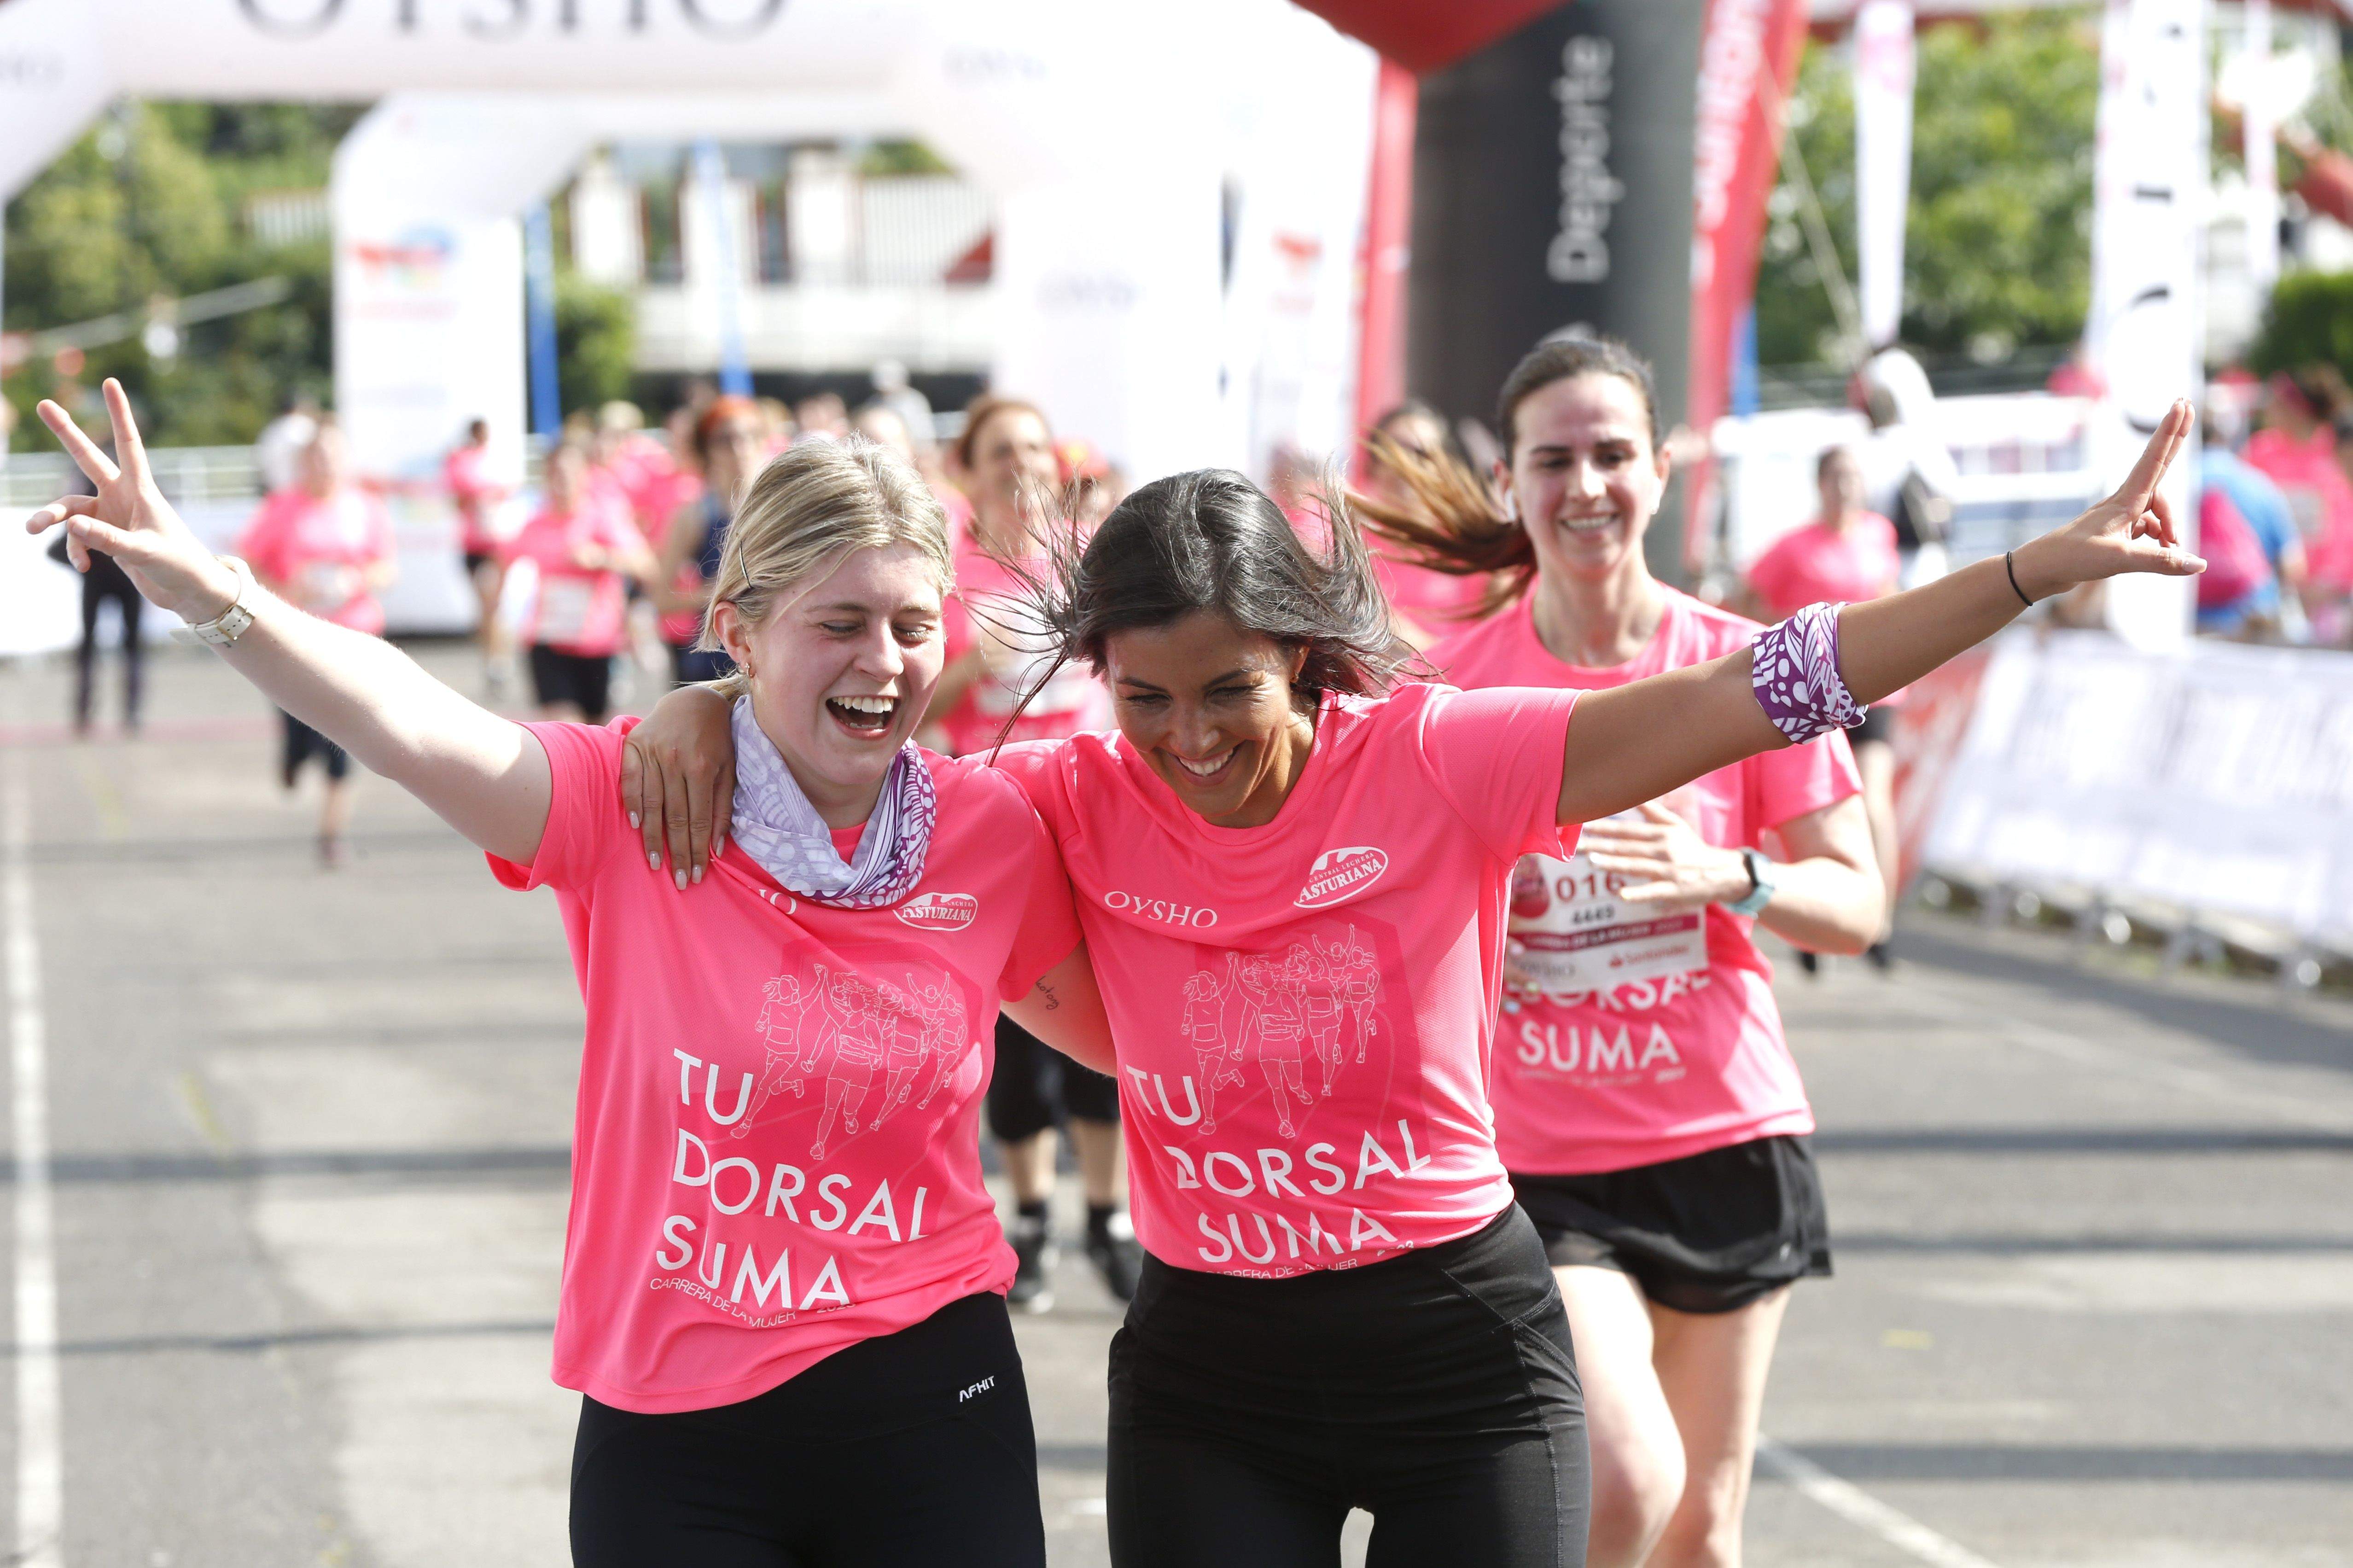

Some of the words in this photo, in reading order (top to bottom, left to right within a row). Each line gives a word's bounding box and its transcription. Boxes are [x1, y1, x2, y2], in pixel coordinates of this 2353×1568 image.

[1547, 35, 1625, 283] Deporte
[1299, 859, 1383, 903] ASTURIANA
[1309, 867, 1340, 883] CENTRAL
[1342, 852, 1374, 870] LECHERA
[902, 907, 971, 921] ASTURIANA
[1104, 891, 1218, 928] OYSHO
[1517, 1020, 1682, 1073] SUMA
[673, 1048, 753, 1125] TU
[1126, 1064, 1202, 1126] TU
[673, 1128, 928, 1242] DORSAL
[1164, 1119, 1431, 1198] DORSAL
[656, 1215, 850, 1310] SUMA
[1198, 1208, 1398, 1264] SUMA
[1276, 1266, 1294, 1278] DE
[650, 1278, 711, 1302] CARRERA
[712, 1295, 731, 1312] DE
[731, 1307, 747, 1321] LA
[749, 1311, 796, 1328] MUJER
